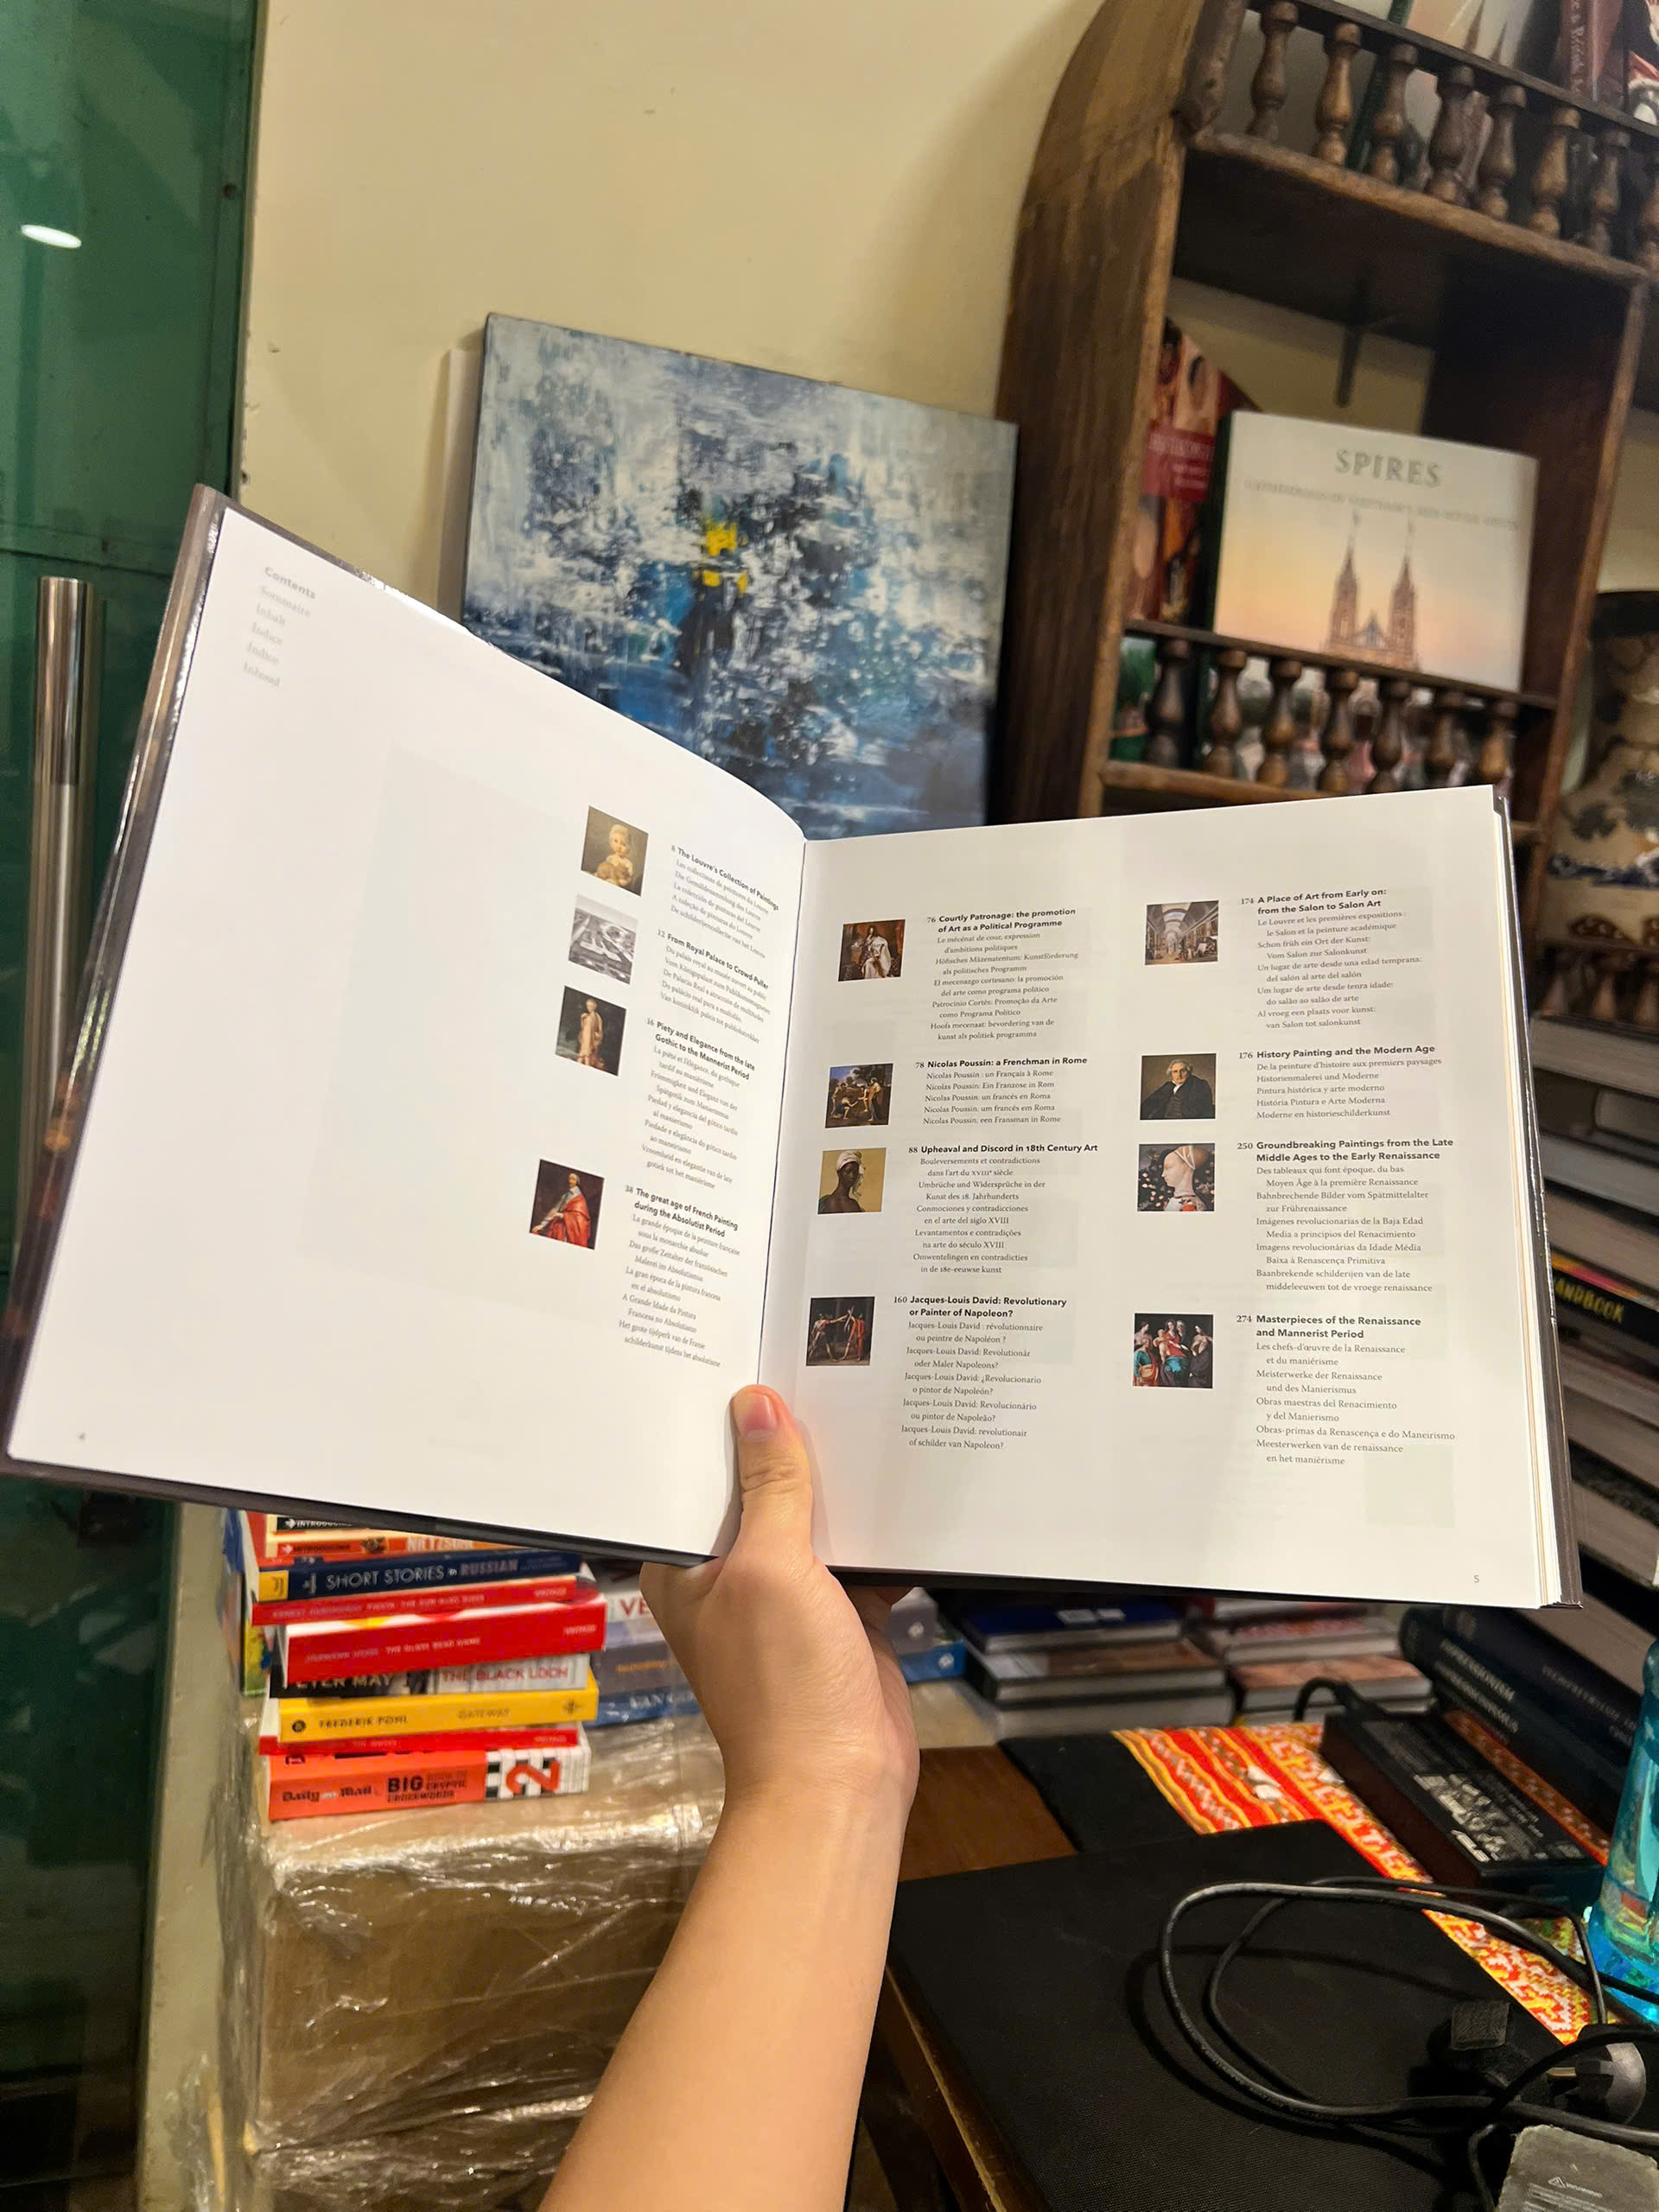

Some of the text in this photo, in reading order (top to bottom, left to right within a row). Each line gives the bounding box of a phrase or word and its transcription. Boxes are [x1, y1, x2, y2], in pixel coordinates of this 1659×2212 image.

[1336, 448, 1443, 488] SPIRES
[264, 566, 316, 600] Contents
[677, 847, 690, 860] The
[691, 854, 718, 874] Louvre's
[718, 868, 749, 891] Collection
[756, 890, 779, 912] Paintings
[1293, 893, 1304, 901] of
[1320, 891, 1344, 899] from
[1345, 889, 1370, 899] Early
[1257, 906, 1280, 915] from
[1298, 904, 1325, 912] Salon
[1338, 900, 1365, 910] Salon
[938, 914, 969, 923] Courtly
[969, 912, 1014, 921] Patronage:
[1031, 908, 1076, 919] promotion
[938, 925, 947, 933] of
[979, 921, 1013, 931] Political
[1014, 920, 1063, 930] Programme
[657, 929, 769, 990] 12 From Royal Palace to Crowd-Puller
[646, 1017, 755, 1071] 16 Piety and Elegance from the late
[655, 1033, 750, 1081] Gothic to the Mannerist Period
[1256, 1050, 1291, 1059] History
[1293, 1048, 1332, 1058] Painting
[1334, 1047, 1353, 1056] and
[1355, 1046, 1371, 1055] the
[1374, 1046, 1413, 1054] Modern
[1414, 1045, 1435, 1055] Age
[927, 1059, 957, 1068] Nicolas
[959, 1058, 994, 1067] Poussin:
[1002, 1058, 1050, 1066] Frenchman
[1256, 1110, 1294, 1119] Moderne
[1306, 1109, 1390, 1118] historieschilderkunst
[920, 1145, 961, 1155] Upheaval
[962, 1144, 979, 1153] and
[980, 1144, 1014, 1153] Discord
[1026, 1144, 1046, 1153] 18th
[1046, 1144, 1083, 1154] Century
[1255, 1140, 1336, 1150] Groundbreaking
[1338, 1140, 1385, 1149] Paintings
[1386, 1139, 1411, 1147] from
[1413, 1138, 1430, 1147] the
[1432, 1138, 1454, 1147] Late
[1256, 1154, 1291, 1162] Middle
[1292, 1154, 1318, 1164] Ages
[1332, 1152, 1349, 1161] the
[1351, 1152, 1376, 1162] Early
[1378, 1152, 1440, 1160] Renaissance
[625, 1184, 634, 1194] 38
[636, 1187, 650, 1199] The
[650, 1194, 670, 1205] great
[670, 1200, 683, 1211] age
[692, 1206, 714, 1220] French
[714, 1214, 739, 1231] Painting
[633, 1200, 726, 1237] during the Absolutist Period
[912, 1253, 969, 1263] Omwentelingen
[980, 1253, 1028, 1262] contradicties
[1266, 1281, 1325, 1291] middeleeuwen
[1341, 1282, 1352, 1291] de
[1353, 1285, 1382, 1294] vroege
[910, 1295, 970, 1306] Jacques-Louis
[972, 1296, 1001, 1305] David:
[1003, 1296, 1067, 1308] Revolutionary
[920, 1307, 951, 1317] Painter
[952, 1308, 963, 1317] of
[963, 1308, 1014, 1319] Napoleon?
[1236, 1314, 1421, 1326] 274 Masterpieces of the Renaissance
[1255, 1327, 1364, 1338] and Mannerist Period
[1255, 1396, 1282, 1406] Obras
[1322, 1398, 1336, 1408] del
[1338, 1399, 1397, 1409] Renacimiento
[326, 1570, 380, 1591] SHORT
[384, 1565, 445, 1585] STORIES
[460, 1559, 518, 1577] RUSSIAN
[1473, 1574, 1480, 1584] 5
[442, 1671, 467, 1683] THE
[476, 1669, 525, 1681] BLACK
[505, 1759, 561, 1796] 2
[387, 1776, 423, 1794] BIG
[283, 1786, 372, 1802] Daily Mail
